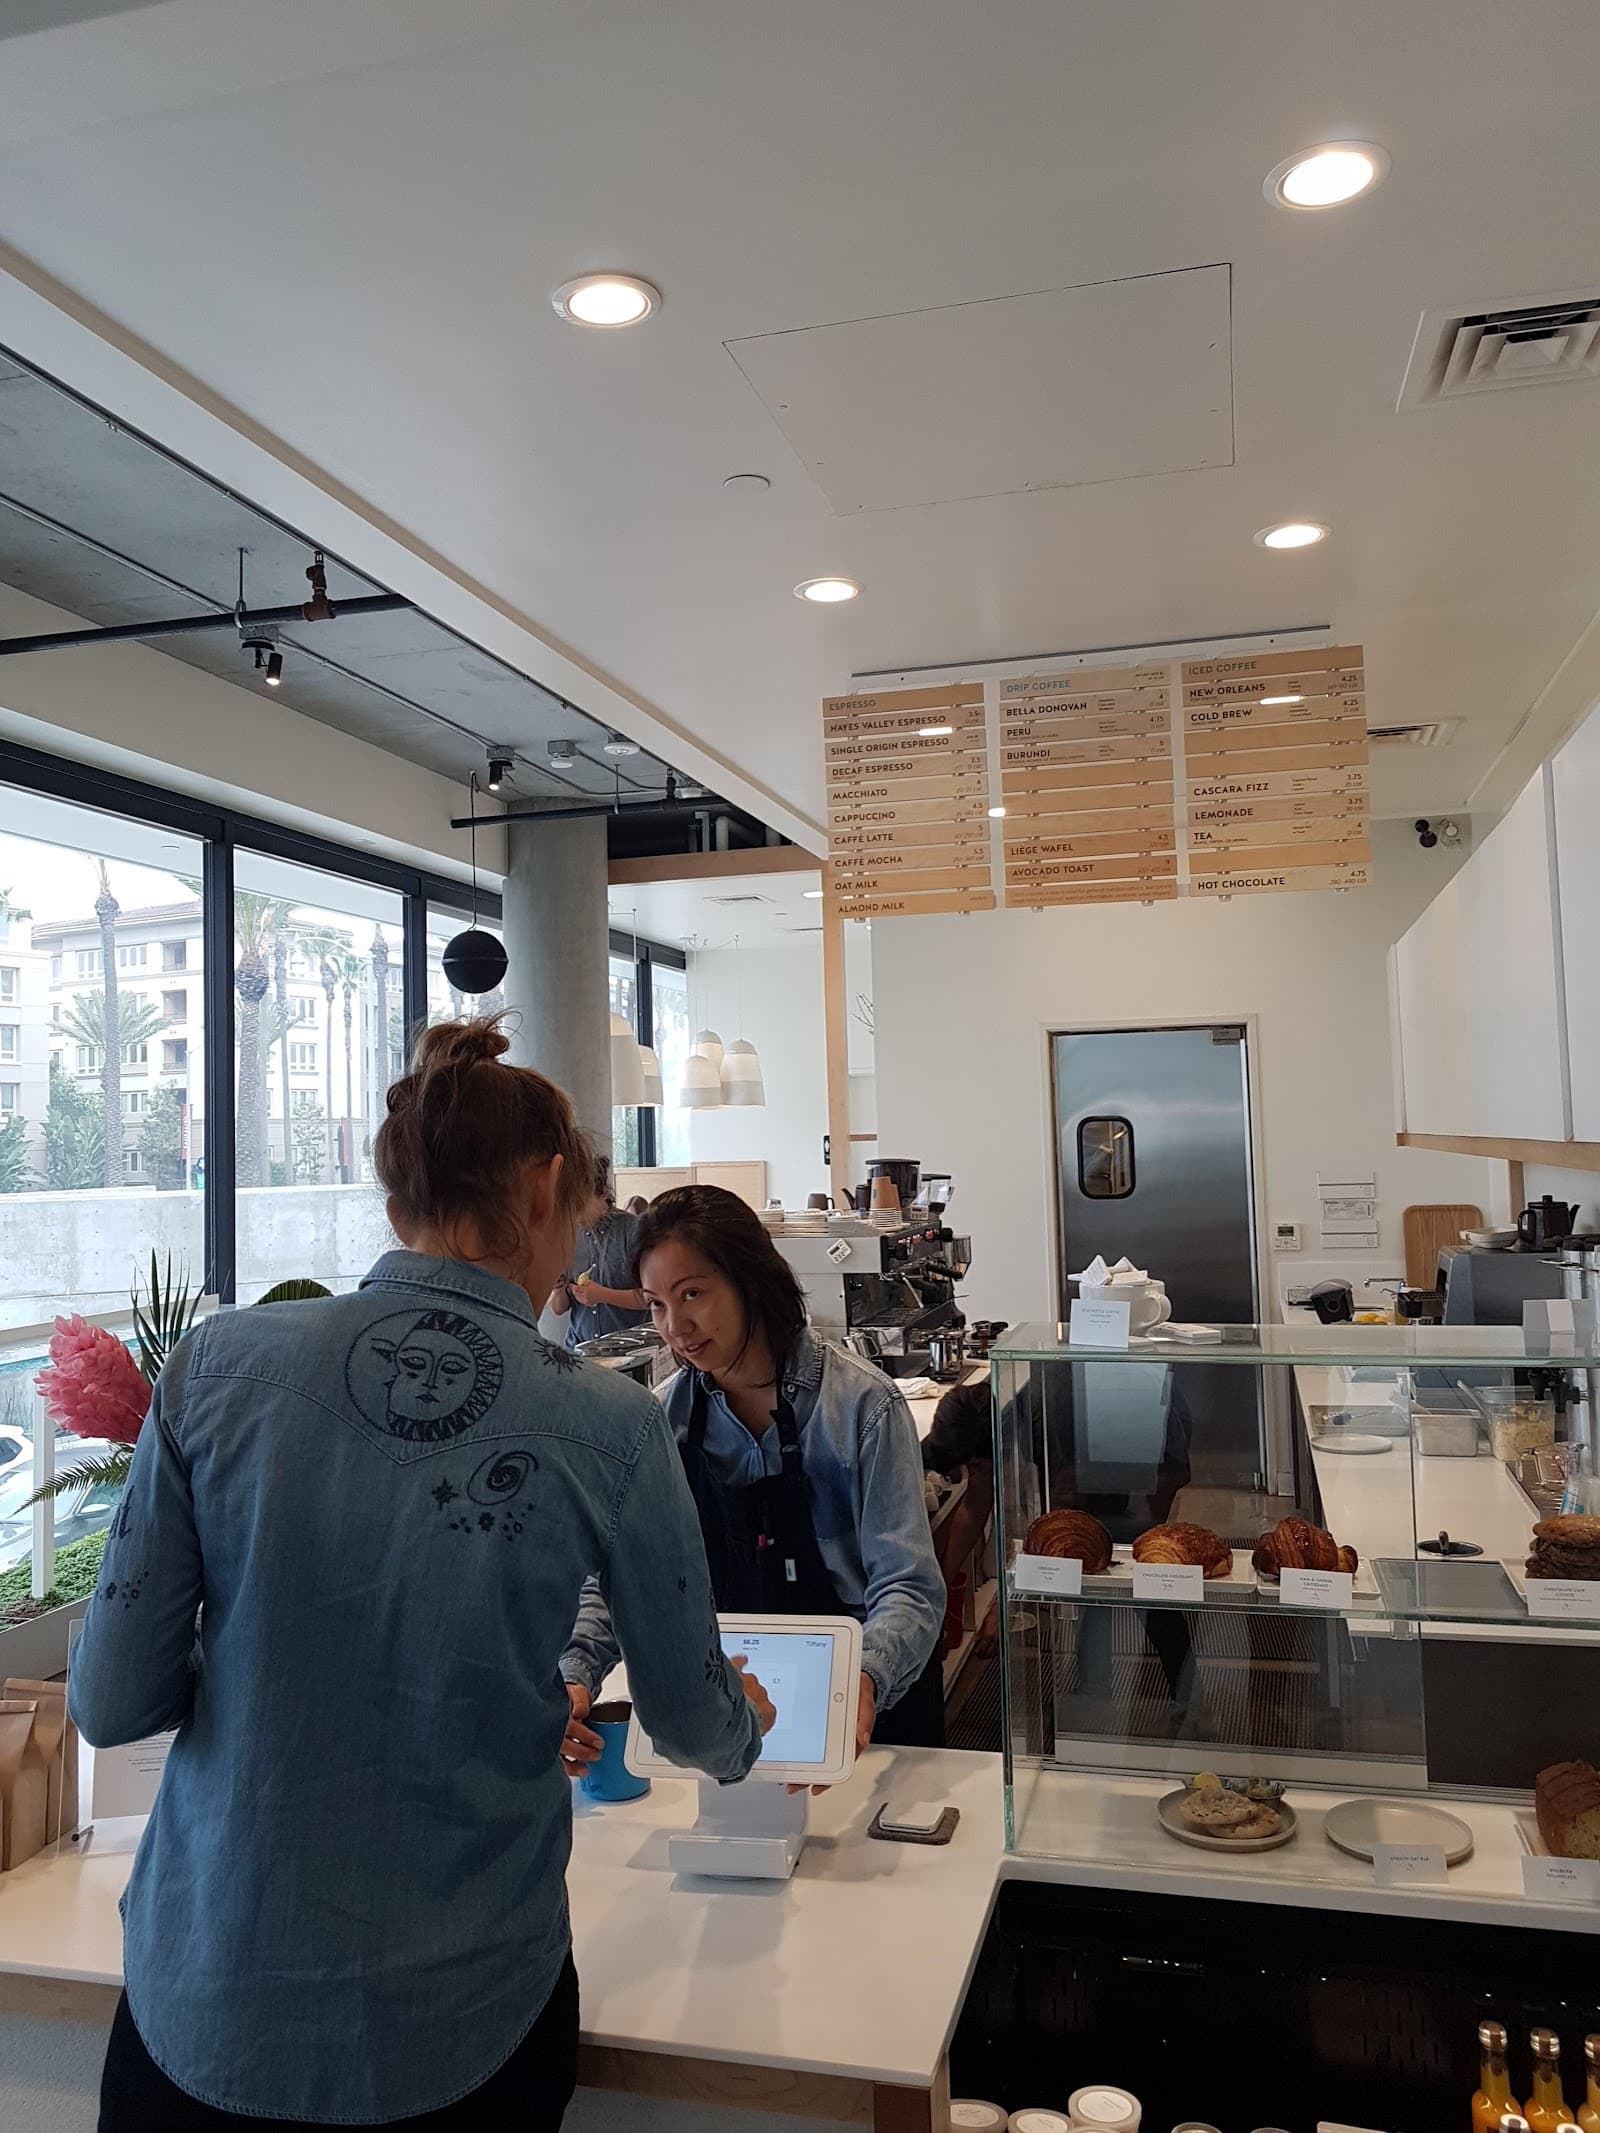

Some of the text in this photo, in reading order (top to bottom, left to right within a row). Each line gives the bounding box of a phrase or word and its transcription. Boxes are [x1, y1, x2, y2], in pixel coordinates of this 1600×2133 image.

[1188, 661, 1257, 675] ICED COFFEE
[1006, 680, 1071, 693] DRIP COFFEE
[1189, 683, 1266, 698] NEW ORLEANS
[829, 699, 877, 711] ESPRESSO
[1006, 708, 1036, 717] BELLA
[1038, 702, 1088, 714] DONOVAN
[1190, 709, 1253, 721] COLD BREW
[830, 715, 947, 732] HAYES VALLEY ESPRESSO
[1006, 727, 1032, 737] PERU
[831, 737, 950, 756] SINGLE ORIGIN ESPRESSO
[1007, 749, 1051, 760] BURUNDI
[832, 763, 914, 776] DECAF ESPRESSO
[832, 788, 888, 800] MACCHIATO
[1194, 782, 1270, 796] CASCARA FIZZ
[834, 811, 896, 823] CAPPUCCINO
[1195, 808, 1254, 820] LEMONADE
[866, 833, 894, 843] LATTE
[1193, 832, 1213, 840] TEA
[1040, 843, 1074, 853] WAFEL
[867, 856, 904, 865] MOCHA
[1012, 864, 1095, 877] AVOCADO TOAST
[834, 880, 879, 890] OAT MILK
[1198, 877, 1286, 890] HOT CHOCOLATE
[838, 901, 905, 913] ALMOND MILK
